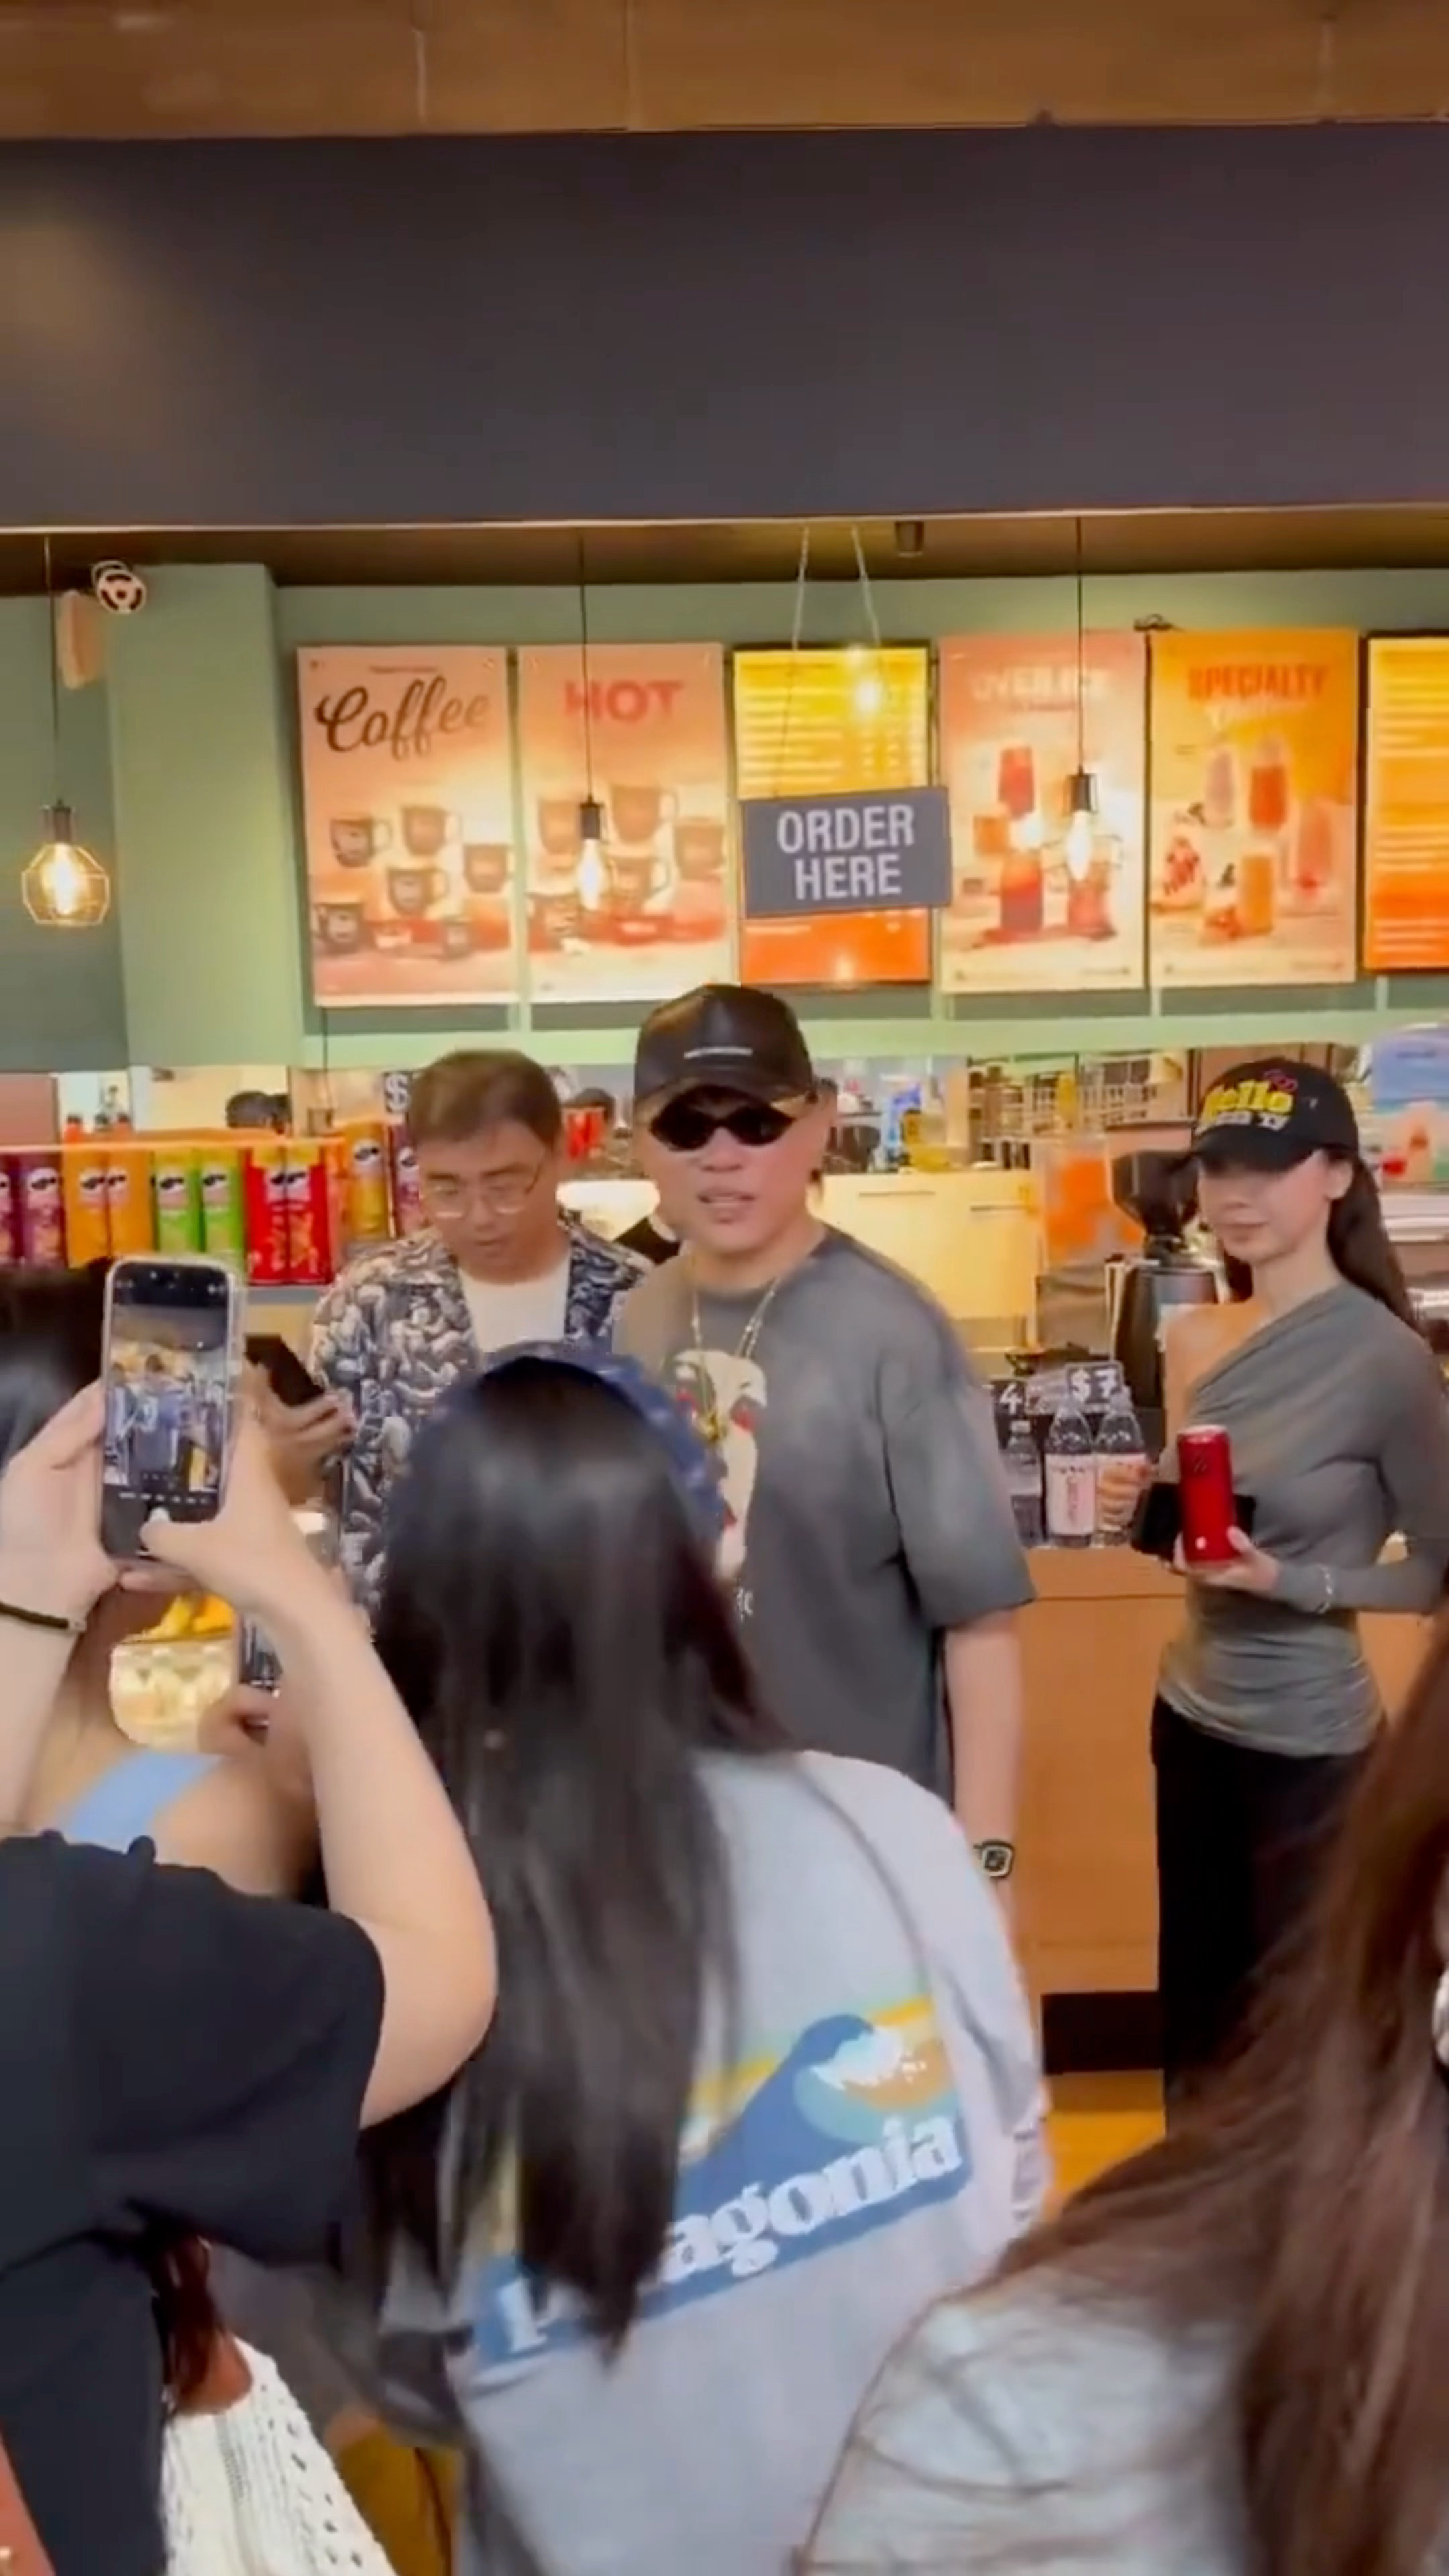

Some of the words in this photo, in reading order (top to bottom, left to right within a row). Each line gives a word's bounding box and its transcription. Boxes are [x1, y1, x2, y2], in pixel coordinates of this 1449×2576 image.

[315, 675, 491, 761] Coffee
[564, 680, 683, 721] HOT
[777, 804, 914, 854] ORDER
[794, 854, 902, 900] HERE
[1071, 1367, 1118, 1402] $7
